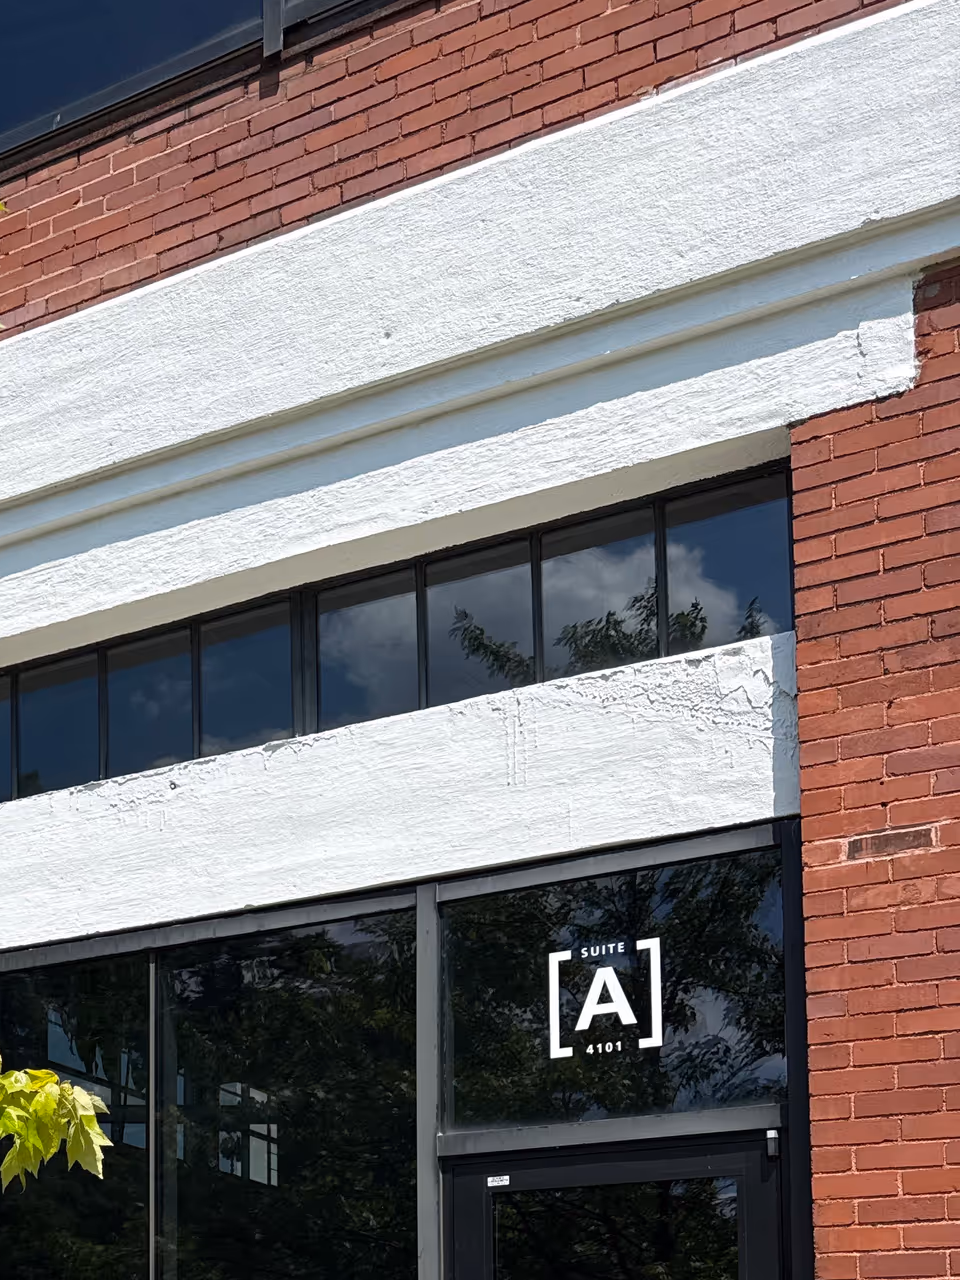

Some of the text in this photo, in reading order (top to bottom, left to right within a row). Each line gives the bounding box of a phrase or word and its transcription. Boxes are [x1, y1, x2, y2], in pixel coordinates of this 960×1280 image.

[581, 942, 625, 958] SUITE
[575, 967, 637, 1031] A
[586, 1041, 622, 1054] 4101
